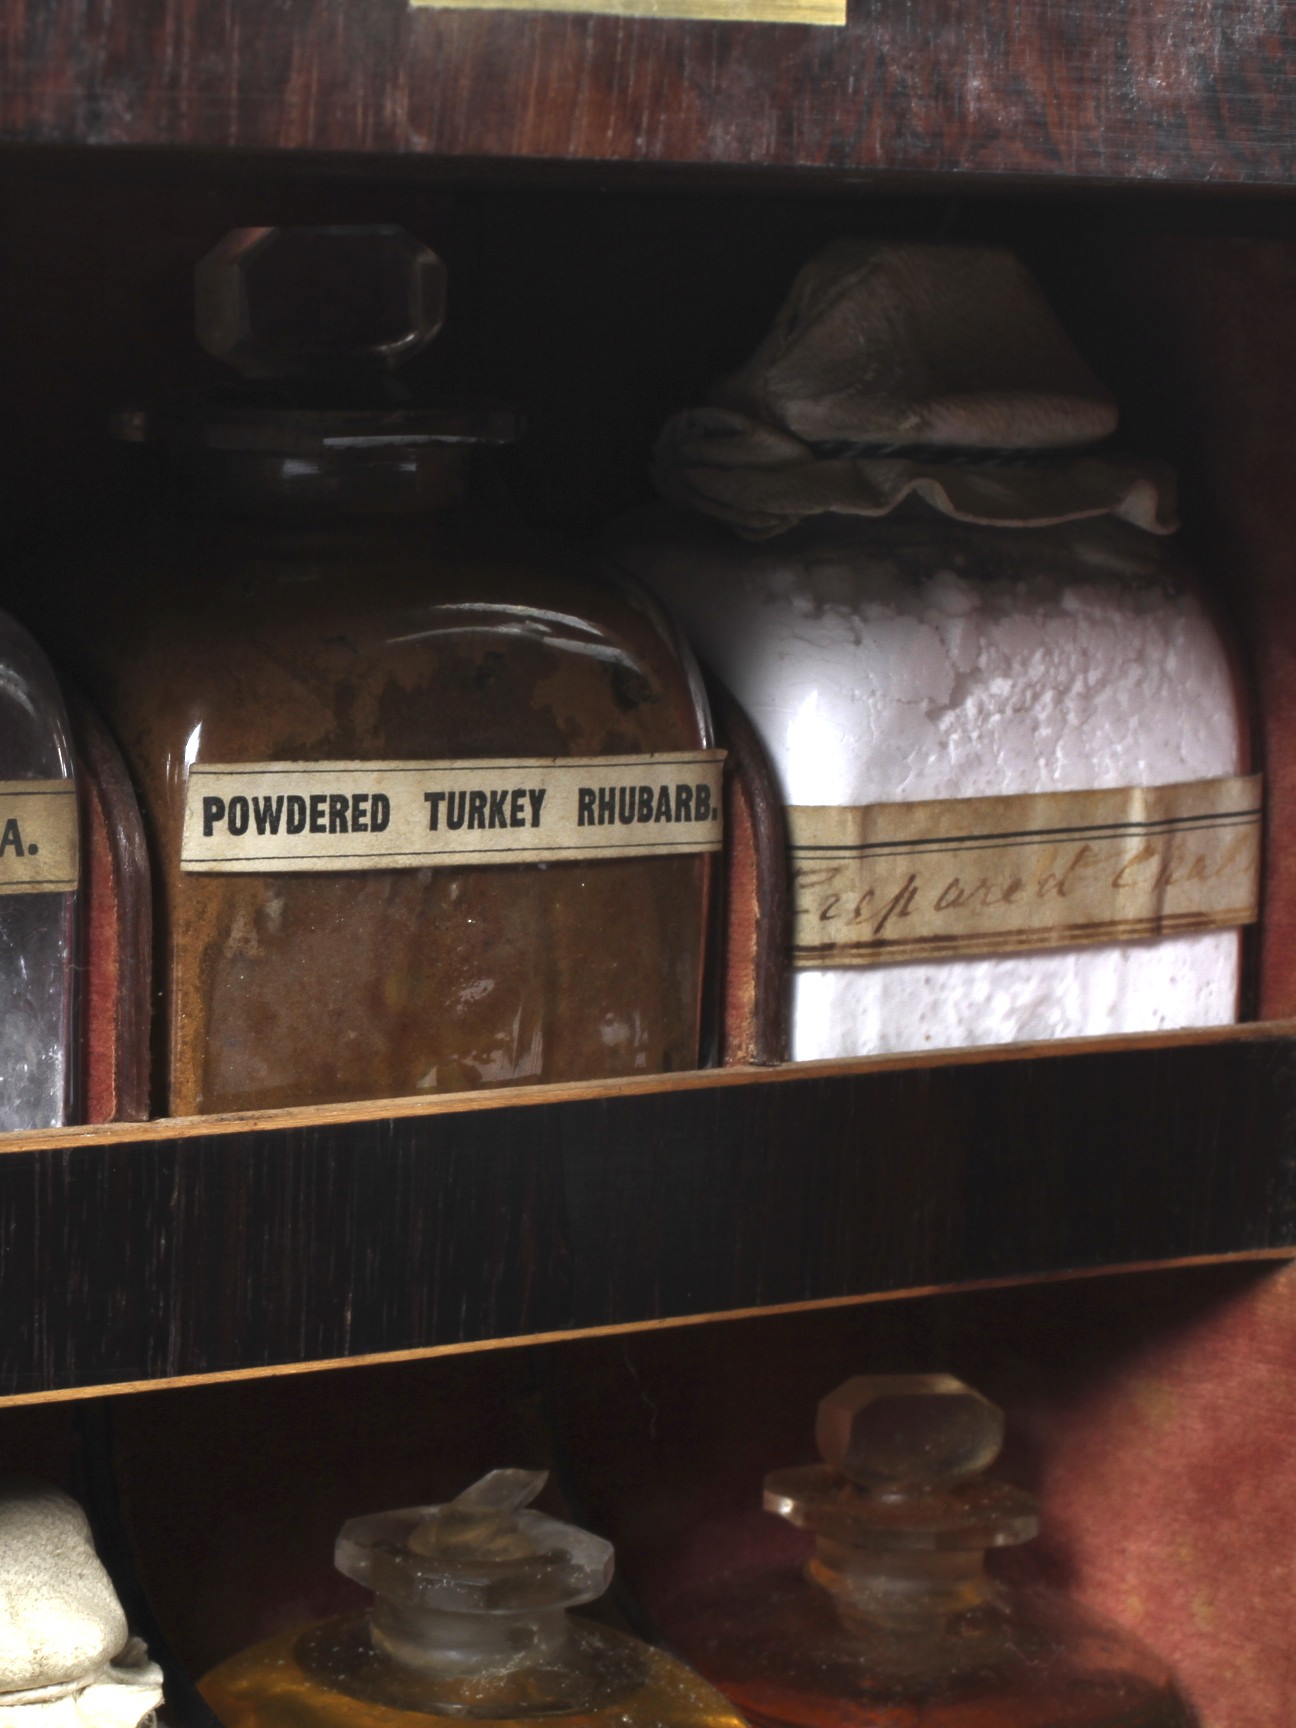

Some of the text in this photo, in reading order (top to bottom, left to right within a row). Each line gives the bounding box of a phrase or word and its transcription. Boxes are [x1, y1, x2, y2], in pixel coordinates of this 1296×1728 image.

[203, 783, 719, 837] POWDERED TURKEY RHUBARB.
